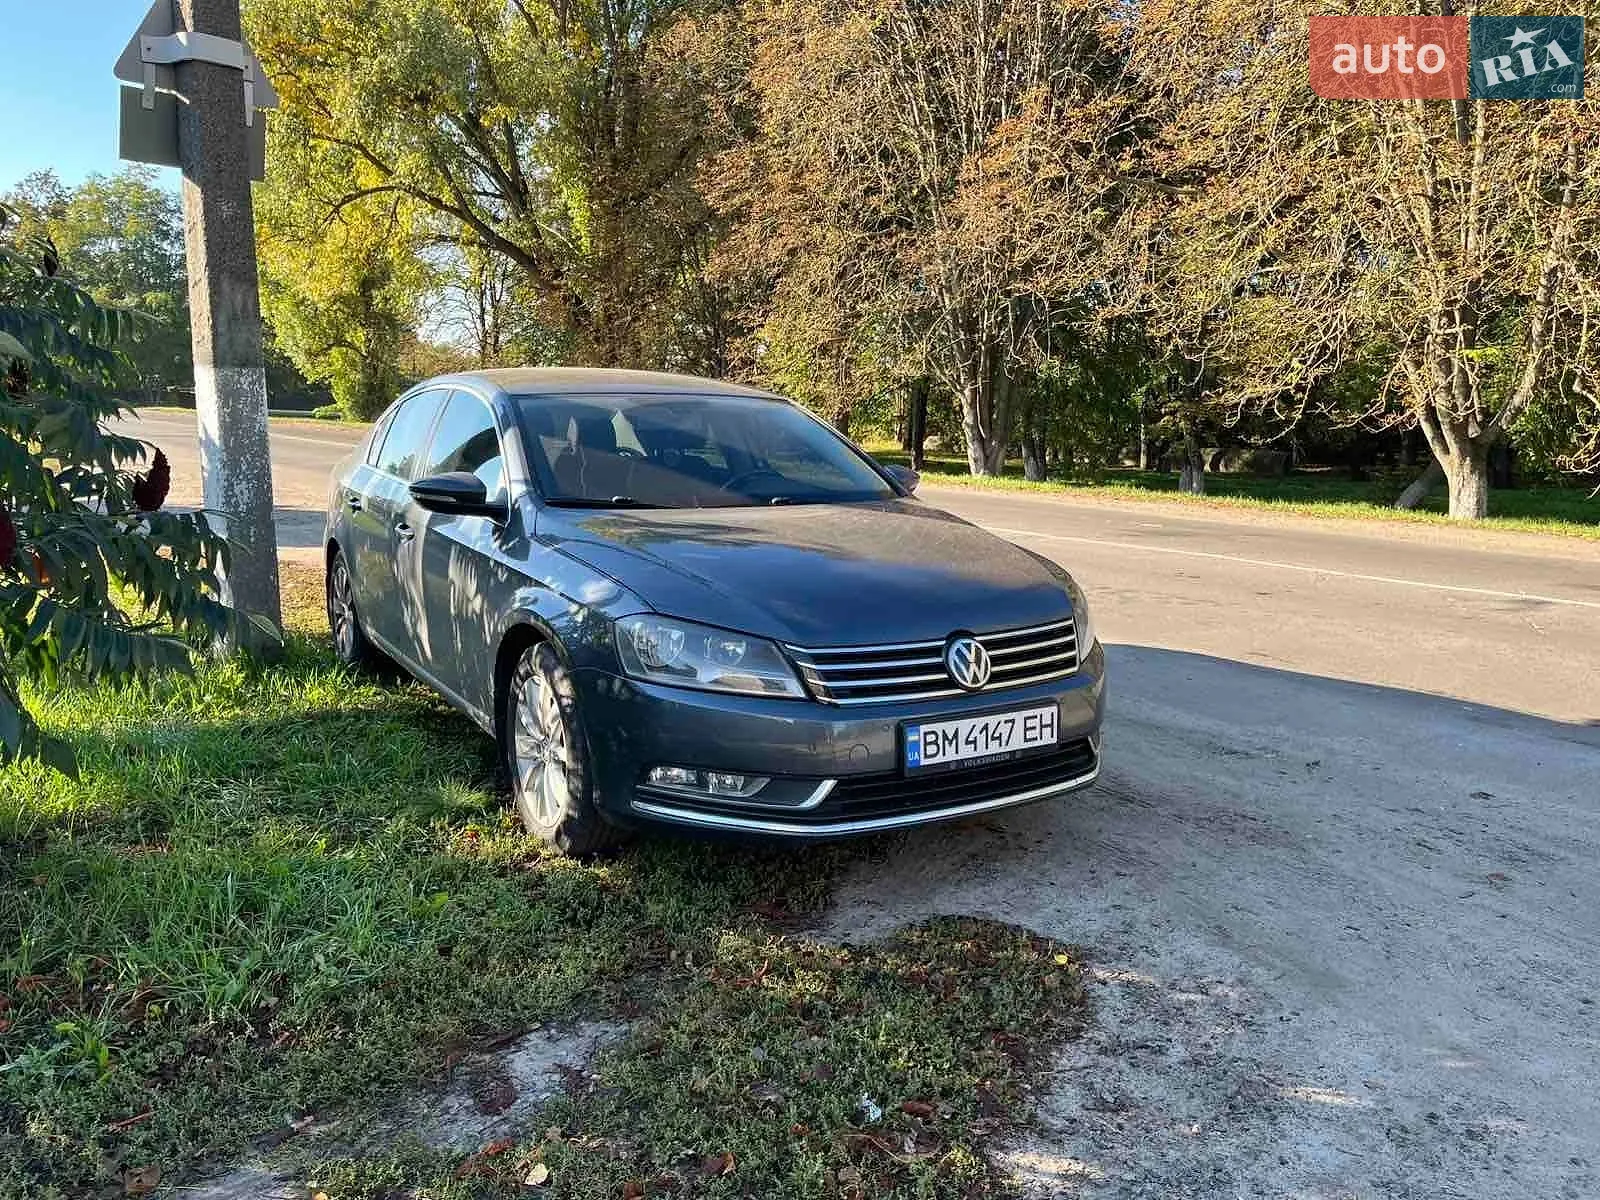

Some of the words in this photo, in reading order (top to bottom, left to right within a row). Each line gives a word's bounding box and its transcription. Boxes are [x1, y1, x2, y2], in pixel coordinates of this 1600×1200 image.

[923, 727, 959, 760] BM
[964, 718, 1016, 752] 4147
[1023, 711, 1055, 743] EH
[908, 752, 920, 761] UA
